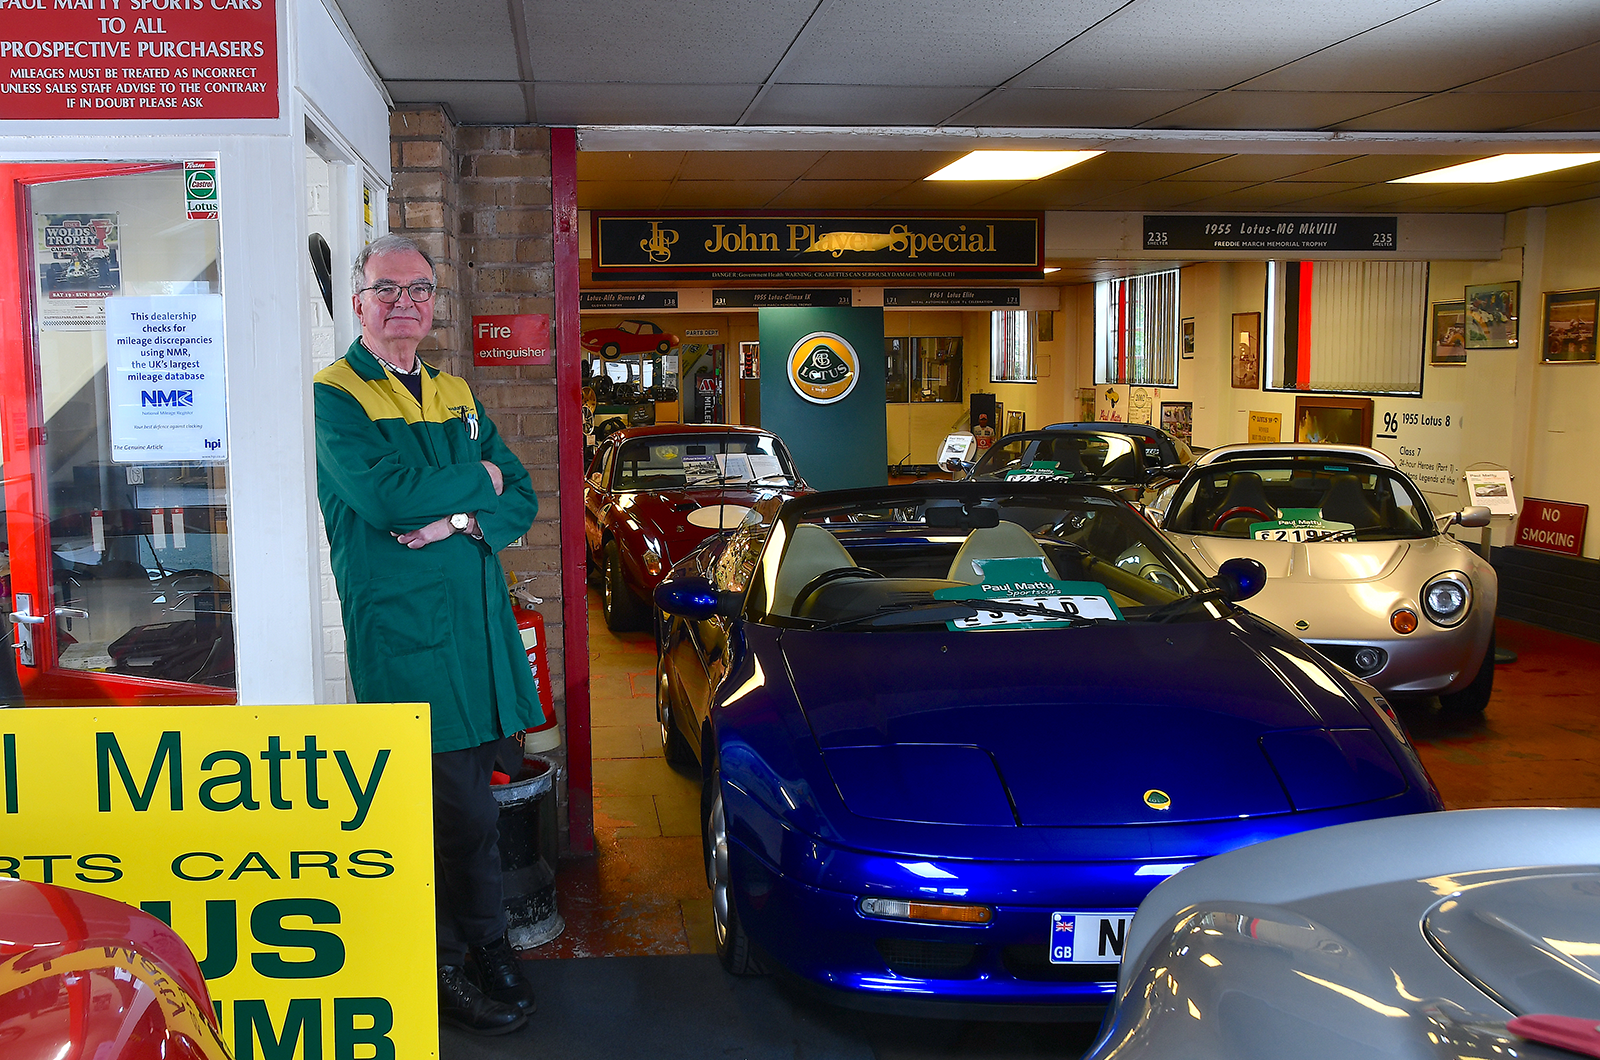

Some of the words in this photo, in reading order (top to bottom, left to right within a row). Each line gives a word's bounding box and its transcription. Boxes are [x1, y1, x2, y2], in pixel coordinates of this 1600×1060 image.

[98, 18, 126, 34] TO
[134, 18, 166, 34] ALL
[0, 41, 130, 58] PROSPECTIVE
[138, 41, 264, 58] PURCHASERS
[10, 68, 64, 79] MILEAGES
[68, 68, 100, 79] MUST
[105, 68, 118, 78] BE
[122, 68, 170, 78] TREATED
[174, 68, 188, 78] AS
[192, 67, 256, 78] INCORRECT
[1, 83, 42, 94] UNLESS
[45, 83, 77, 94] SALES
[81, 83, 112, 94] STAFF
[116, 83, 156, 94] ADVISE
[160, 82, 176, 94] TO
[180, 82, 200, 93] THE
[204, 82, 267, 94] CONTRARY
[66, 98, 76, 108] IF
[80, 98, 92, 108] IN
[96, 98, 134, 108] DOUBT
[140, 98, 178, 108] PLEASE
[182, 98, 203, 108] ASK
[187, 201, 218, 210] Lotus
[46, 228, 90, 237] WOLDS
[1205, 224, 1231, 234] 1955
[1240, 223, 1294, 235] Lotus-MG
[1299, 223, 1338, 235] MkVIII
[47, 236, 97, 245] TROPHY
[705, 224, 780, 252] John
[786, 224, 880, 258] Player
[889, 224, 996, 258] Special
[1148, 232, 1168, 242] 235
[1373, 233, 1392, 243] 235
[131, 313, 148, 321] This
[151, 312, 196, 321] dealership
[142, 324, 171, 332] checks
[478, 323, 511, 338] Fire
[117, 337, 152, 346] mileage
[154, 336, 212, 346] discrepancies
[140, 349, 164, 358] using
[166, 349, 191, 357] NMR,
[480, 347, 545, 359] extinguisher
[132, 361, 146, 369] the
[149, 360, 168, 368] UK's
[170, 360, 200, 370] largest
[128, 373, 163, 383] mileage
[800, 364, 847, 380] LOTUS
[141, 390, 193, 407] NMR
[1384, 412, 1398, 433] 96
[1402, 413, 1418, 424] 1955
[1421, 414, 1442, 426] Lotus
[1445, 415, 1450, 427] 8
[204, 439, 221, 450] hpi
[1400, 446, 1415, 456] Class
[1417, 448, 1421, 456] 7
[1399, 459, 1417, 468] 24-hour
[1417, 461, 1434, 470] Heroes
[1436, 463, 1448, 472] (Part
[1419, 473, 1438, 484] Legends
[1440, 475, 1446, 484] of
[1447, 477, 1455, 485] the
[1542, 507, 1560, 522] NO
[1522, 528, 1574, 548] SMOKING
[1014, 582, 1054, 591] Matty
[96, 731, 391, 831] Matty
[171, 849, 395, 881] CARS
[1054, 946, 1072, 958] GB
